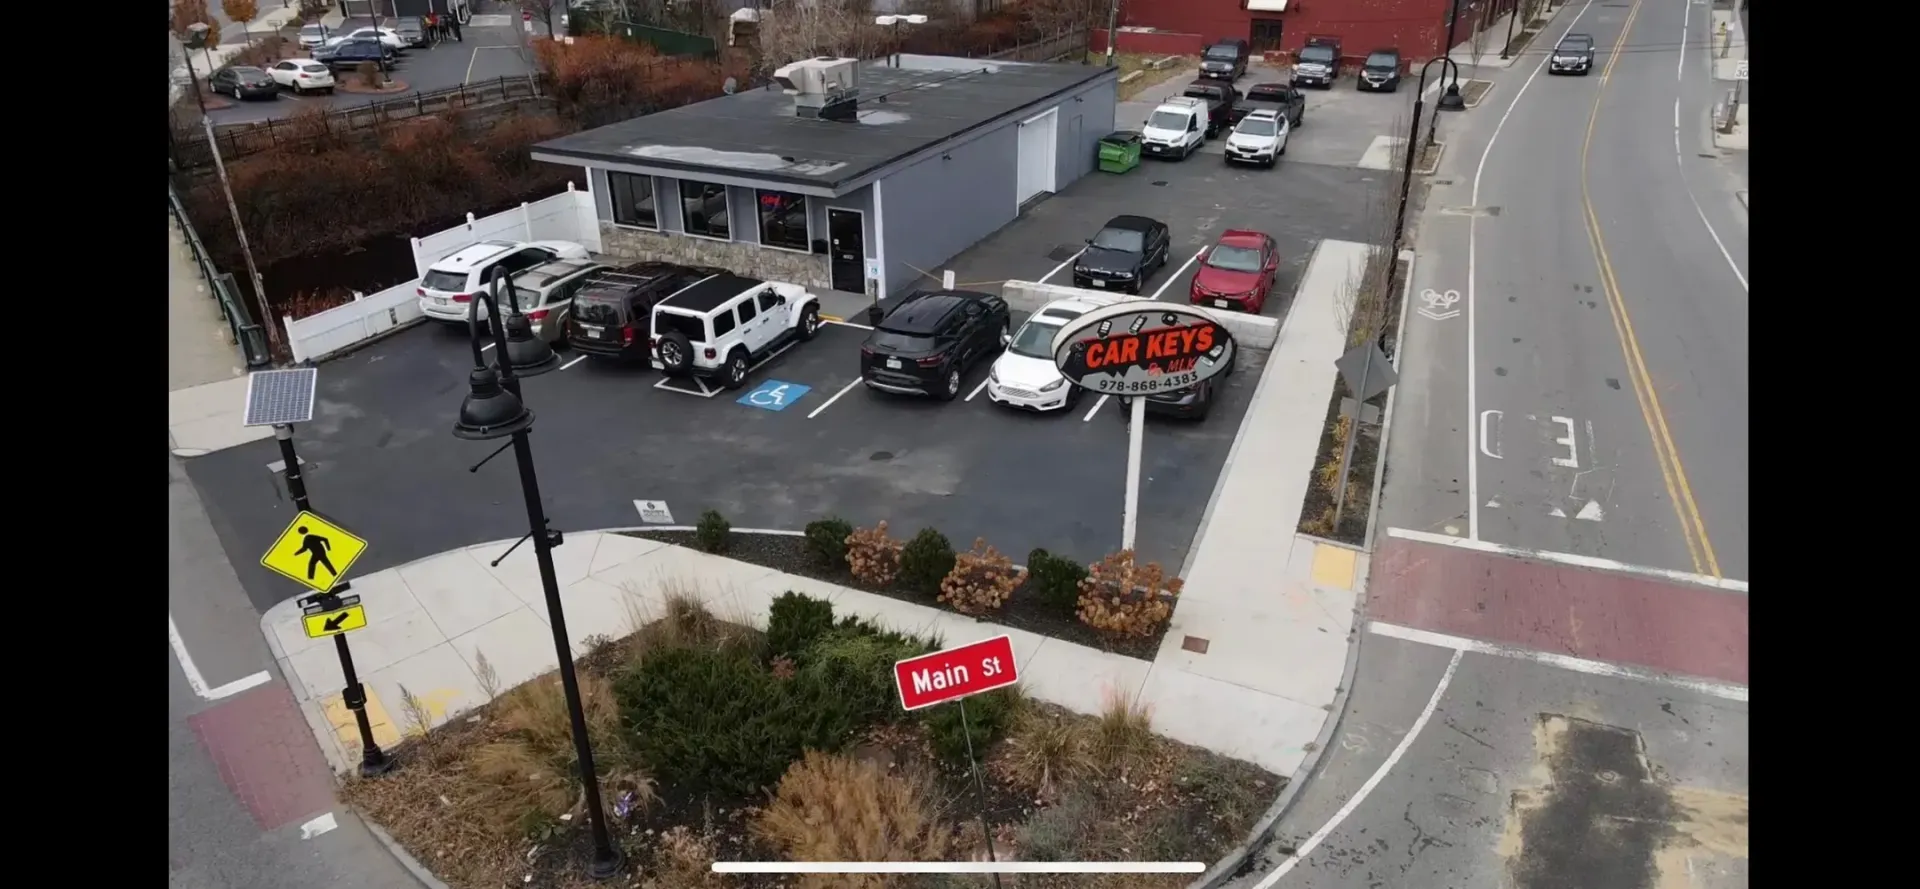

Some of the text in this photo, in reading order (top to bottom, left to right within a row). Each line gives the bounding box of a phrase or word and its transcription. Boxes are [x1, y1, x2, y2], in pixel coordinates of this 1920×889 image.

[1086, 326, 1214, 368] CAR KEYS
[1166, 356, 1197, 373] MLK
[1099, 371, 1198, 392] 978-868-4383
[911, 655, 1002, 695] Main St
